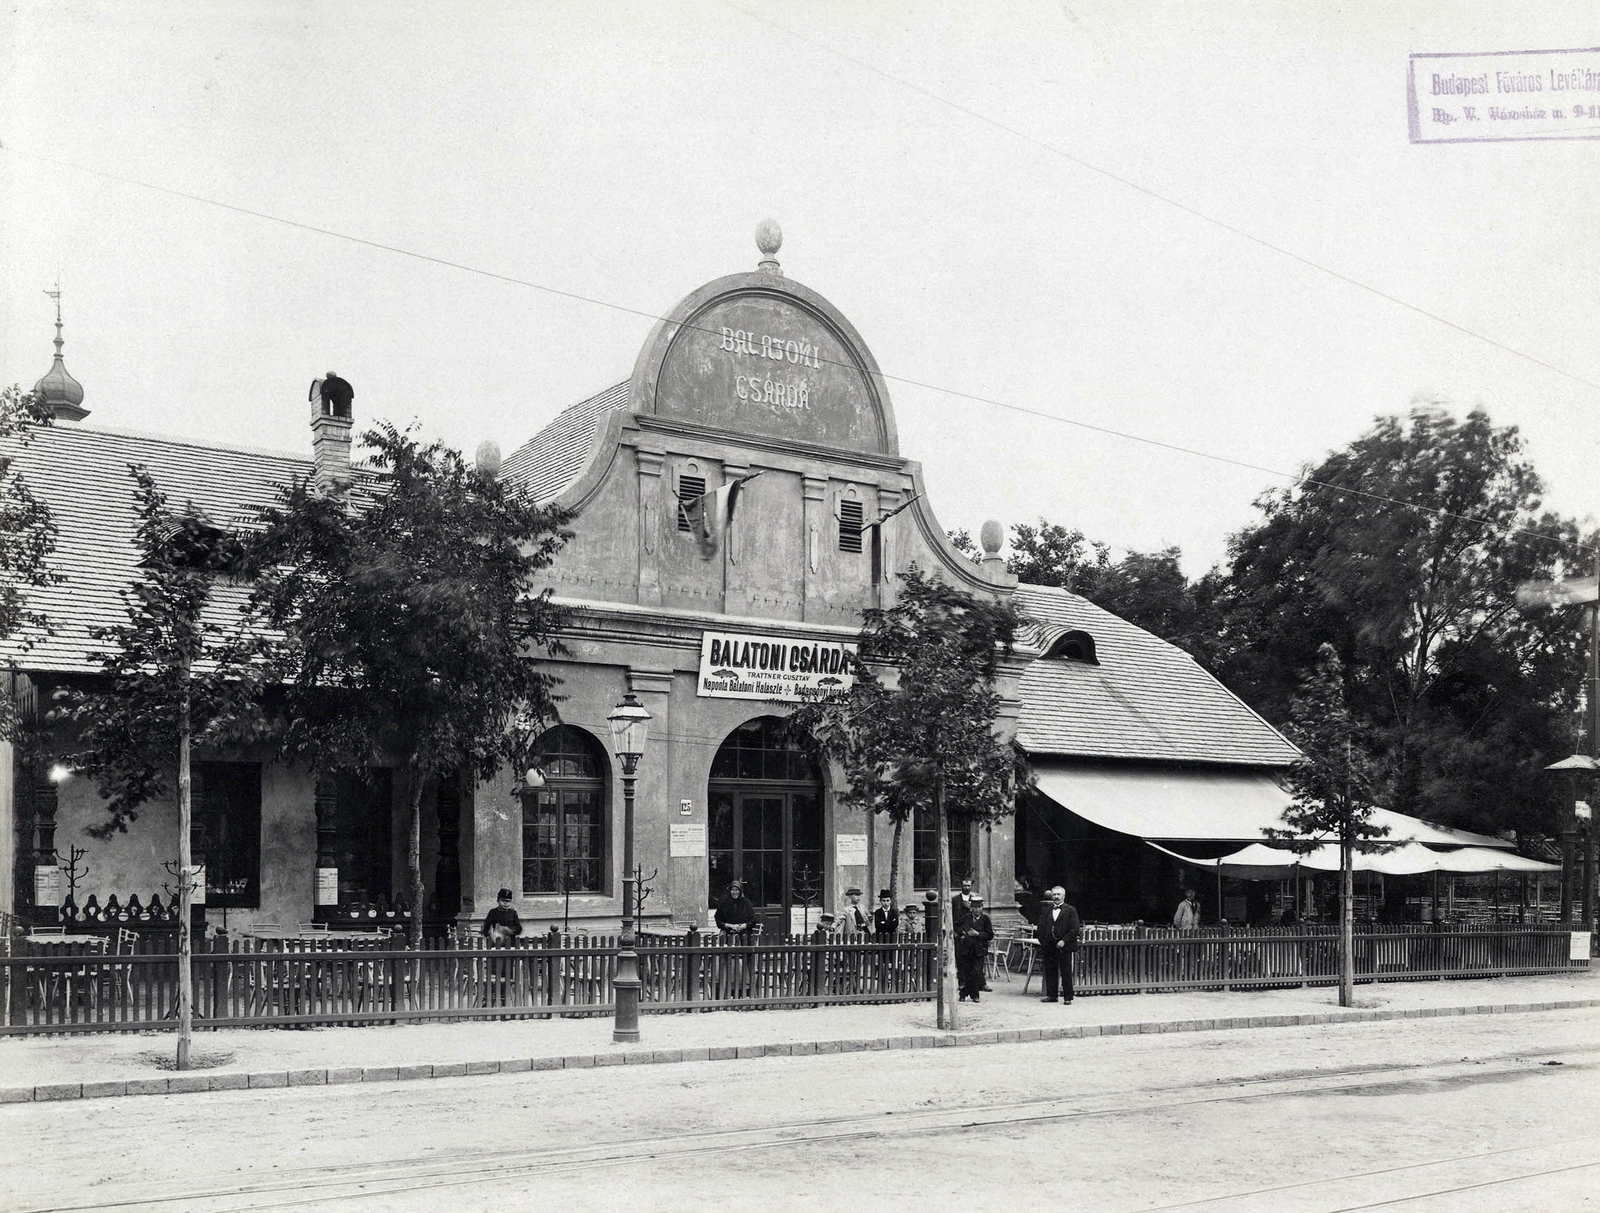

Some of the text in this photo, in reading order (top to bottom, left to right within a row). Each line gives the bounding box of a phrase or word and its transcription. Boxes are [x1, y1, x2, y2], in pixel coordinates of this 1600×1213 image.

[720, 327, 820, 369] BALATONI
[710, 638, 849, 675] BALATONI CSÁRDA
[747, 671, 782, 680] TRATTNER
